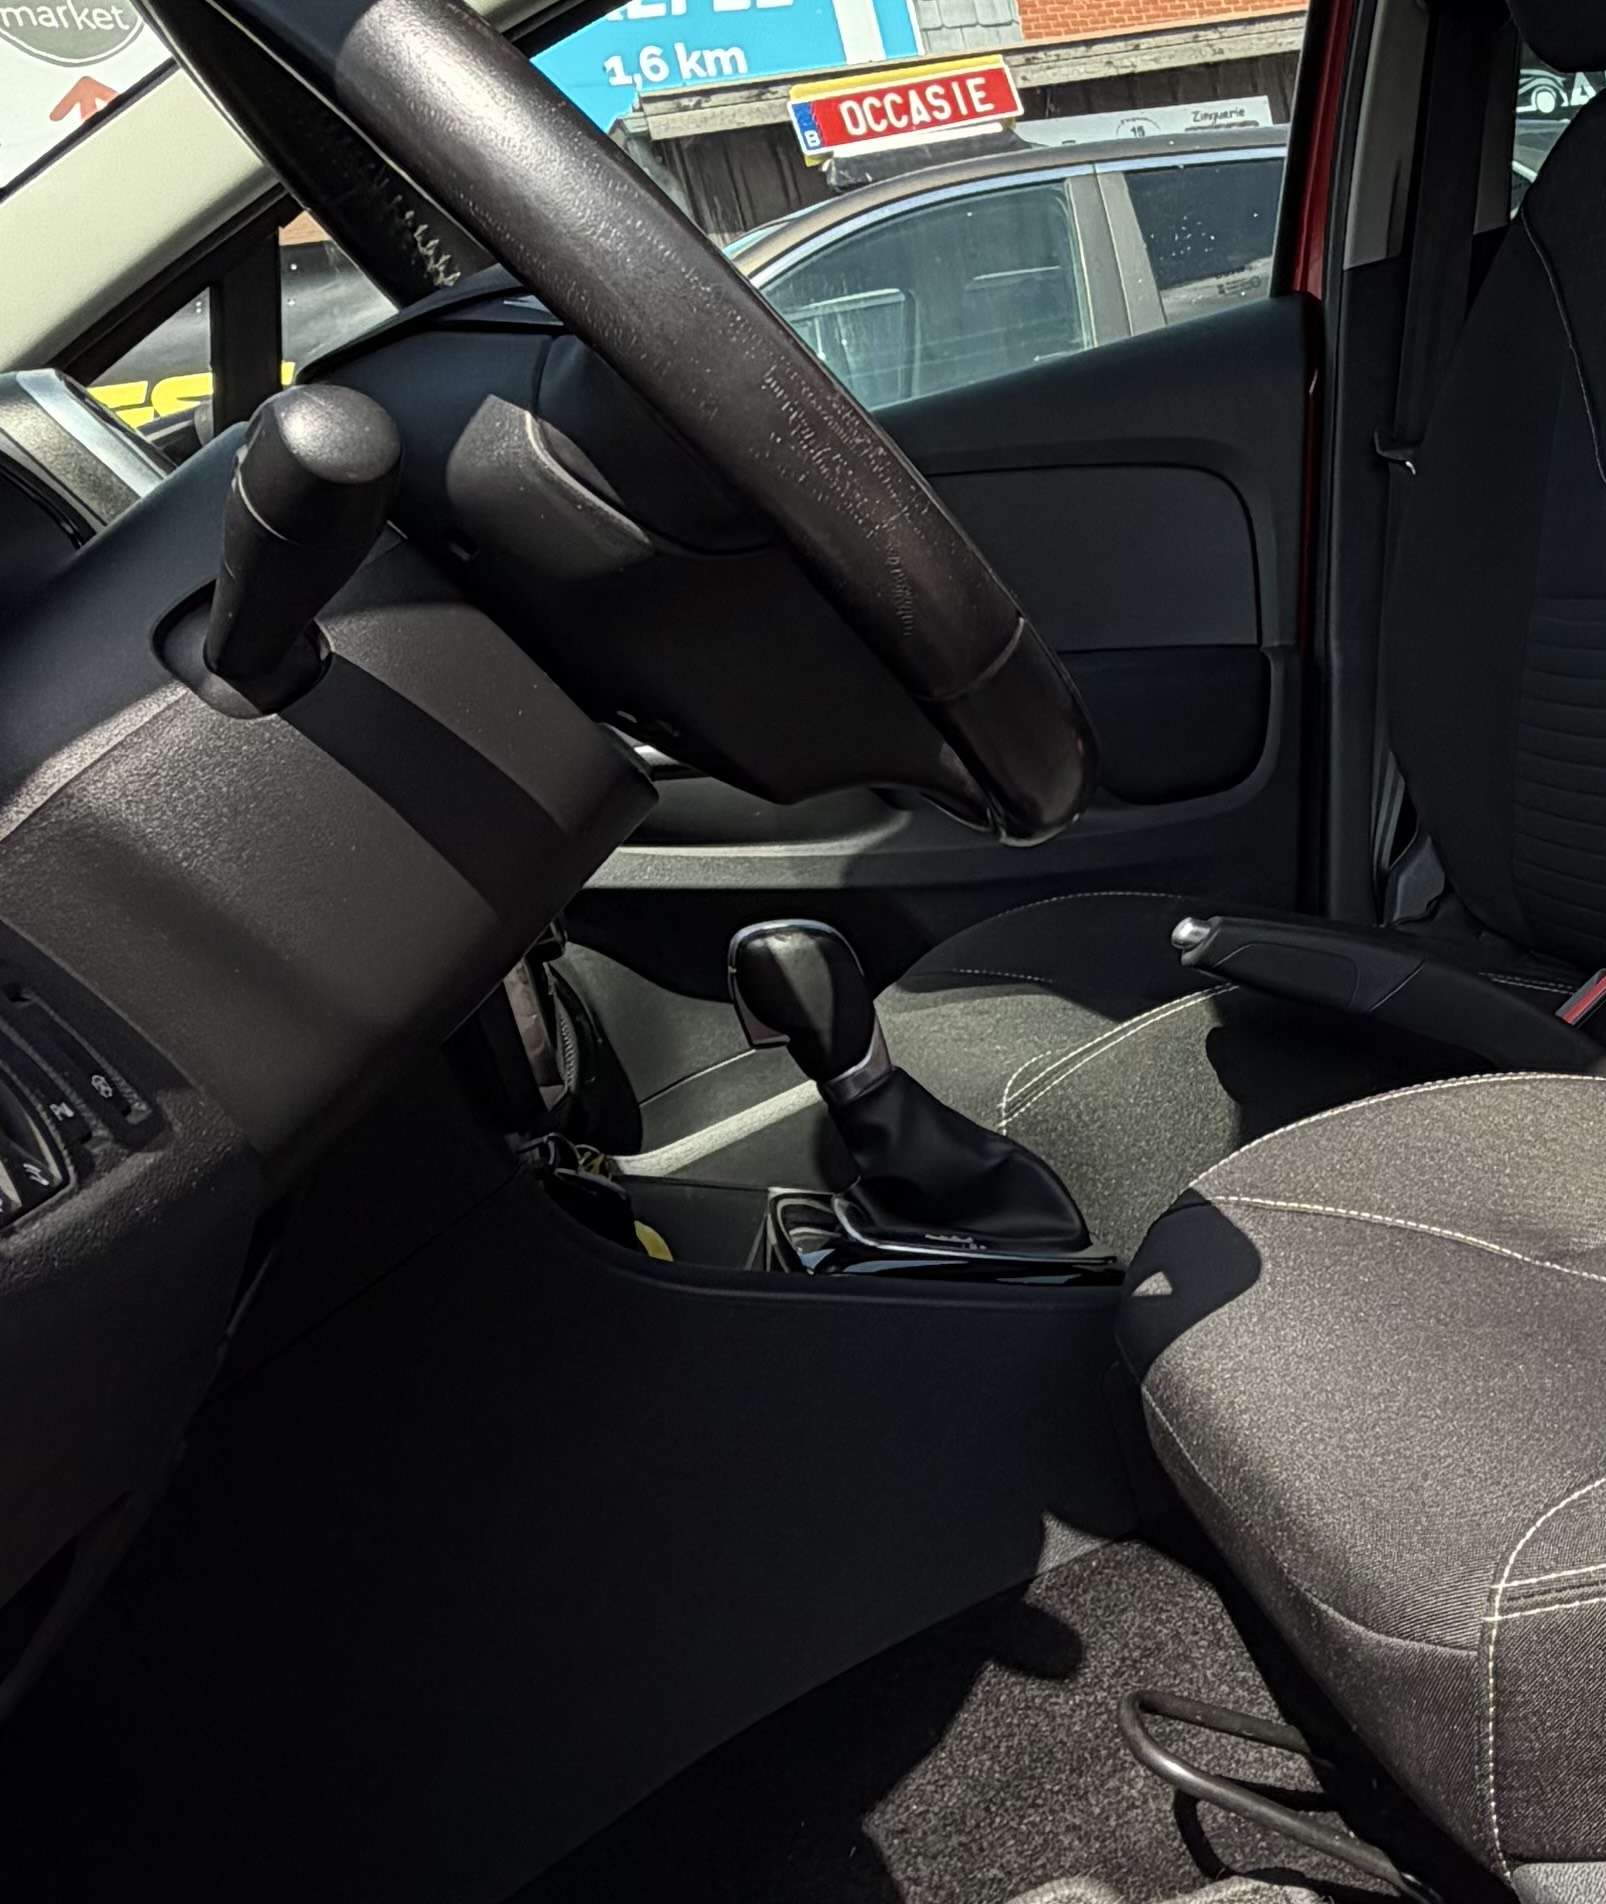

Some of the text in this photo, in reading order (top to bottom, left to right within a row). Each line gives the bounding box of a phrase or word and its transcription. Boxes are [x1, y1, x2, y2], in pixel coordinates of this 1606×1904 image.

[603, 42, 749, 90] 1,6 km
[839, 77, 996, 136] OCCASIE
[804, 130, 821, 147] B
